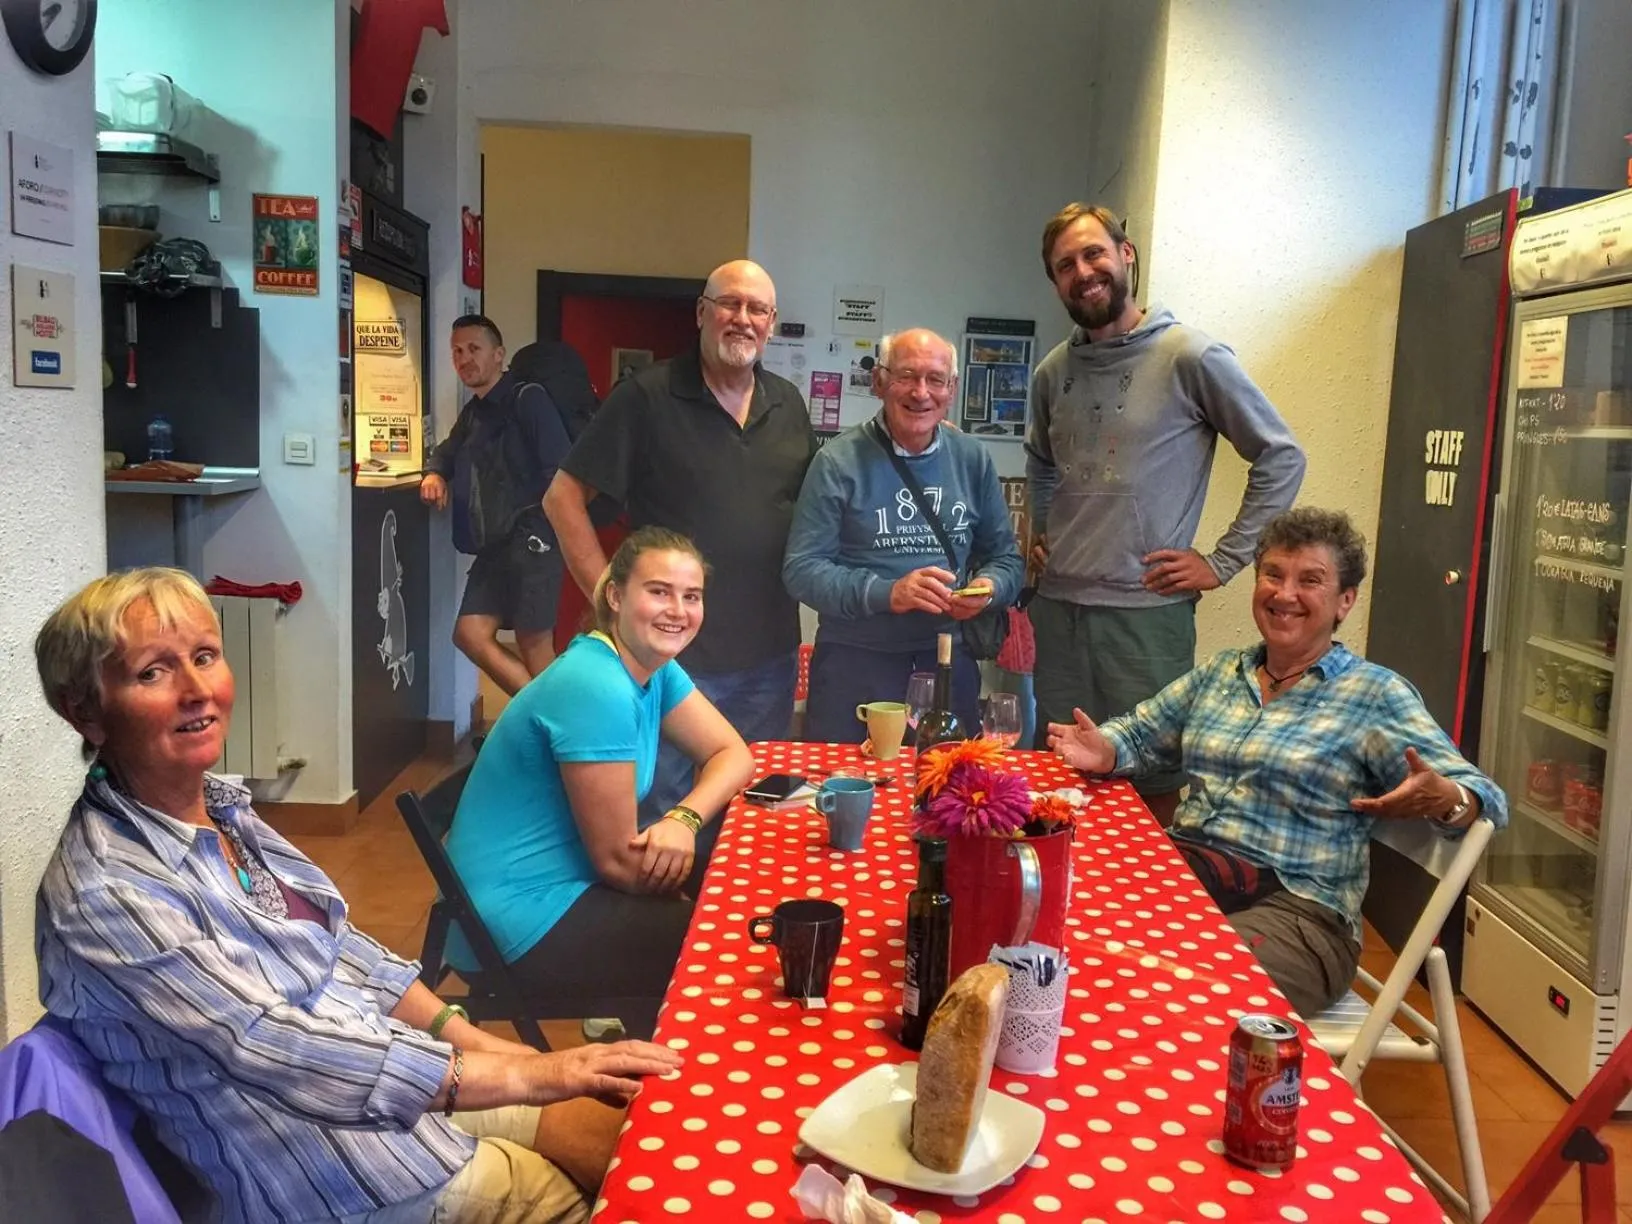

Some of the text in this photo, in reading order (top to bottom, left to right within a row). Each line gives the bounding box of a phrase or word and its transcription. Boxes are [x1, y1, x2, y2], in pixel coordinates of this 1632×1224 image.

[261, 198, 297, 217] TEA
[257, 270, 314, 286] COFFEE
[356, 325, 399, 334] QUE LA VIDA
[360, 335, 400, 347] DESPEINE
[1425, 430, 1465, 466] STAFF
[1425, 470, 1458, 506] ONLY
